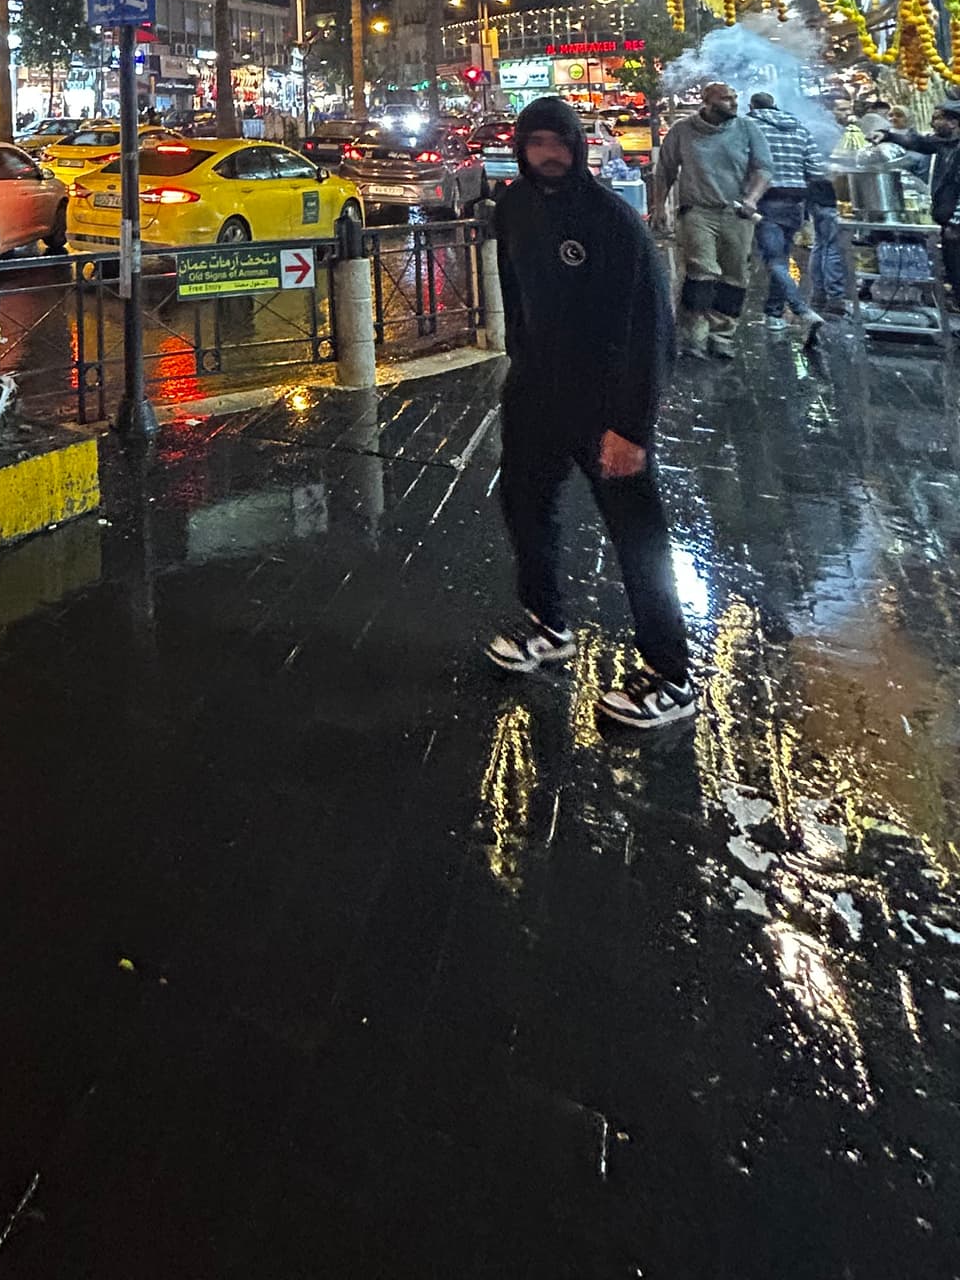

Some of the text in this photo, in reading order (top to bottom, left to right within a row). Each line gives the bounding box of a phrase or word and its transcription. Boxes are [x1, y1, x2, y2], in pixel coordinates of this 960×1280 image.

[240, 252, 278, 266] متحف
[188, 268, 269, 282] Old Signs of Amman
[188, 284, 203, 292] Free
